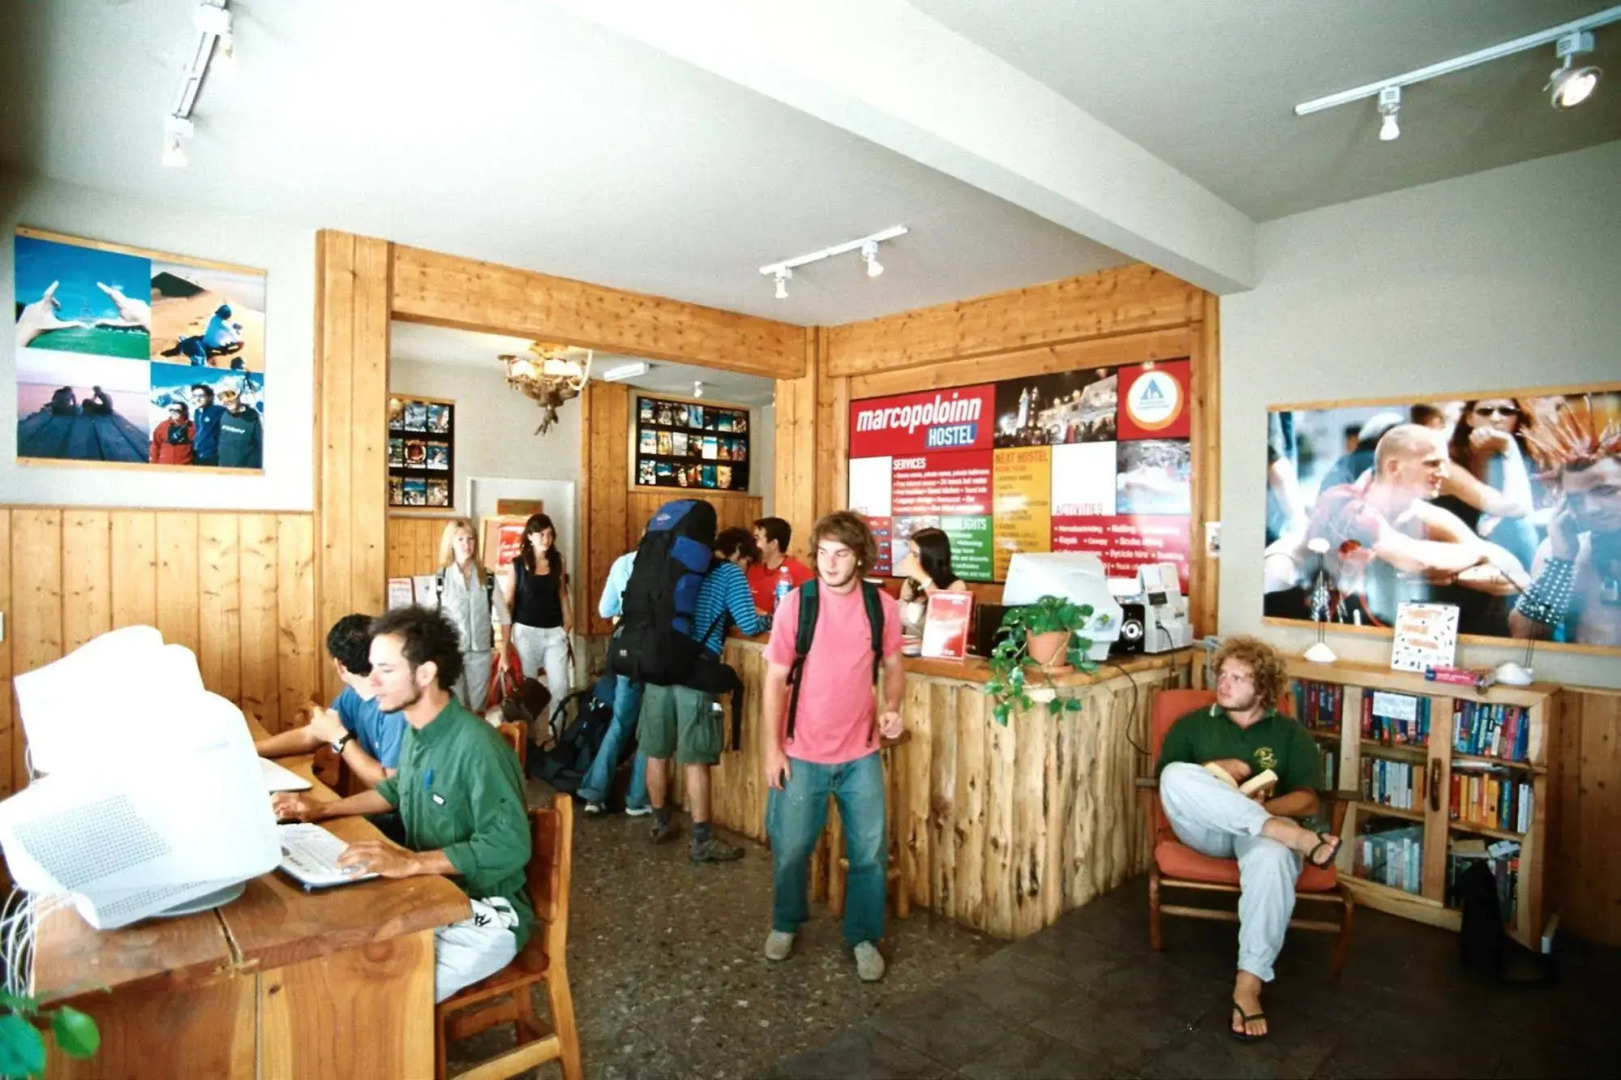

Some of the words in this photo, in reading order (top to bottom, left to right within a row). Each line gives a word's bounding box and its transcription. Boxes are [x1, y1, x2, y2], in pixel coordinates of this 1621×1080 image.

[856, 391, 982, 434] marcopoloinn
[928, 425, 975, 447] HOSTEL
[995, 451, 1015, 463] NEXT
[1017, 449, 1049, 462] HOSTEL
[892, 457, 926, 470] SERVICES
[1055, 502, 1104, 516] ACTIVITIES
